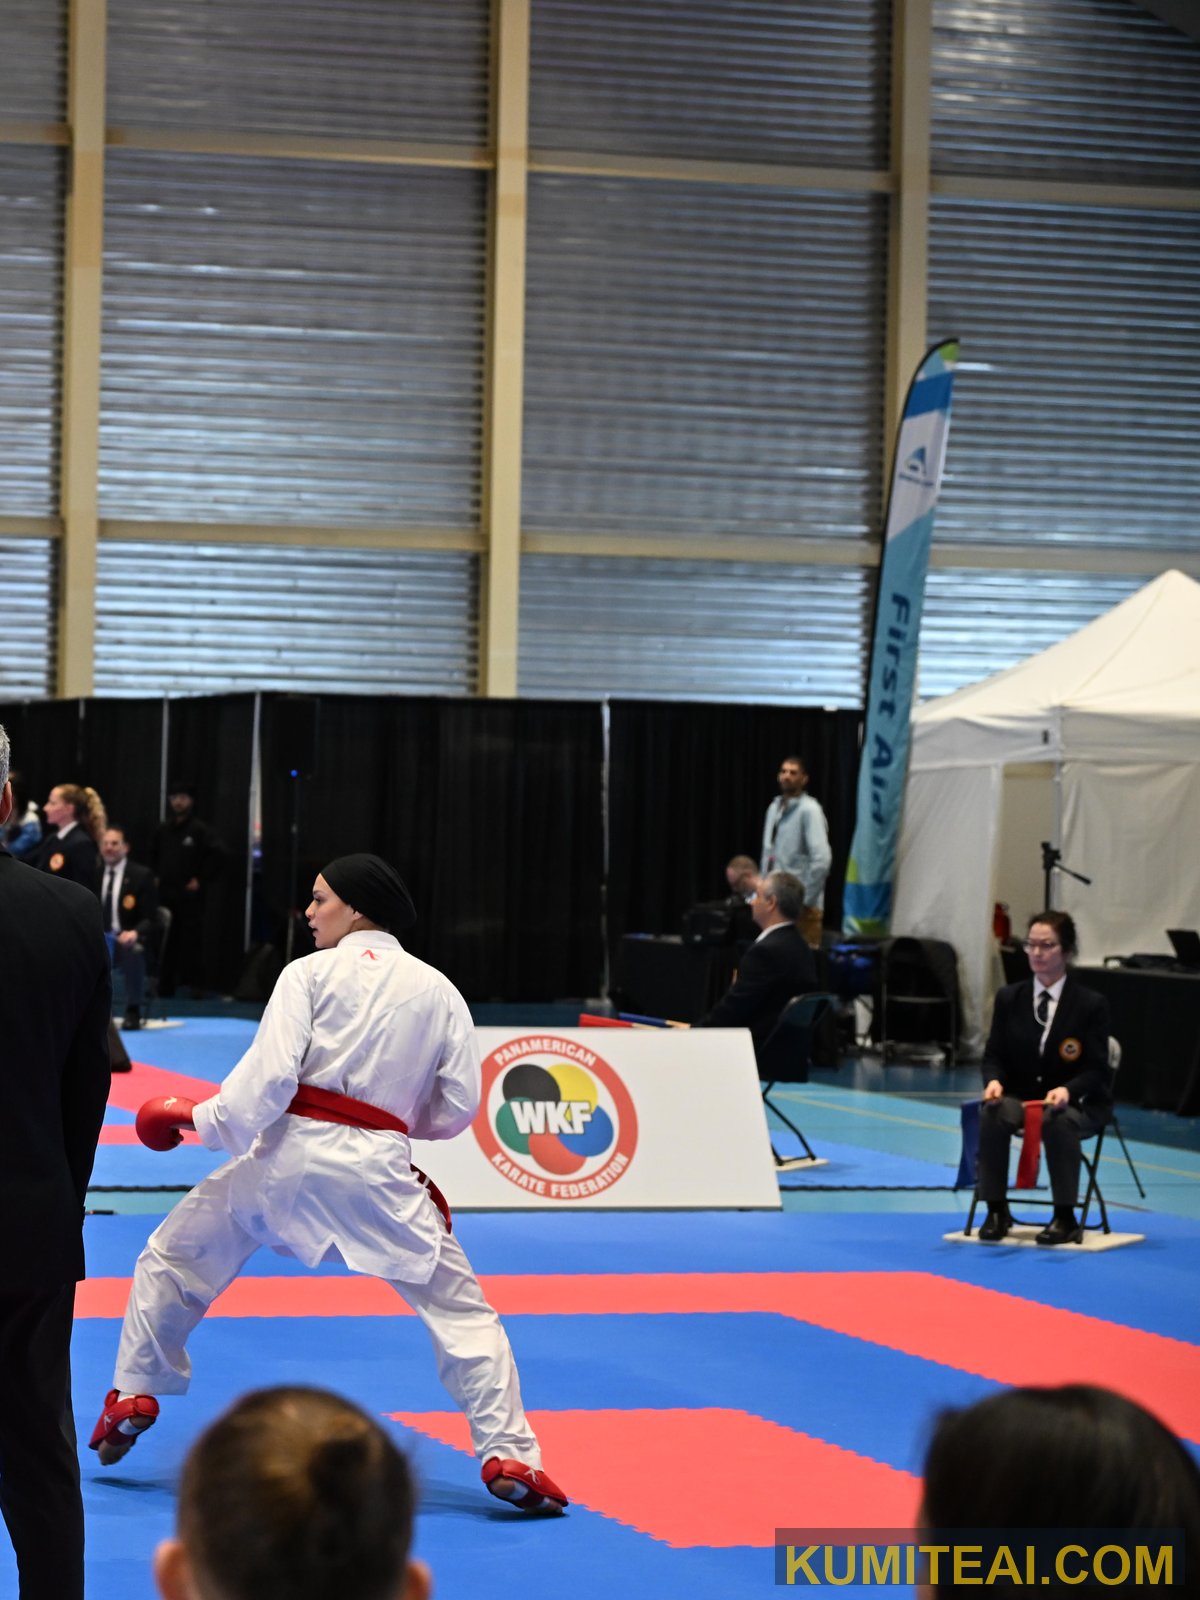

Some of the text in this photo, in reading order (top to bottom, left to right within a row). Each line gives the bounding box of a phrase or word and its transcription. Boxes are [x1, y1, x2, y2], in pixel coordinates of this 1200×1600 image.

[493, 1038, 597, 1067] PANAMERICAN
[510, 1101, 592, 1134] WKF
[491, 1152, 629, 1198] KARATE FEDERATION
